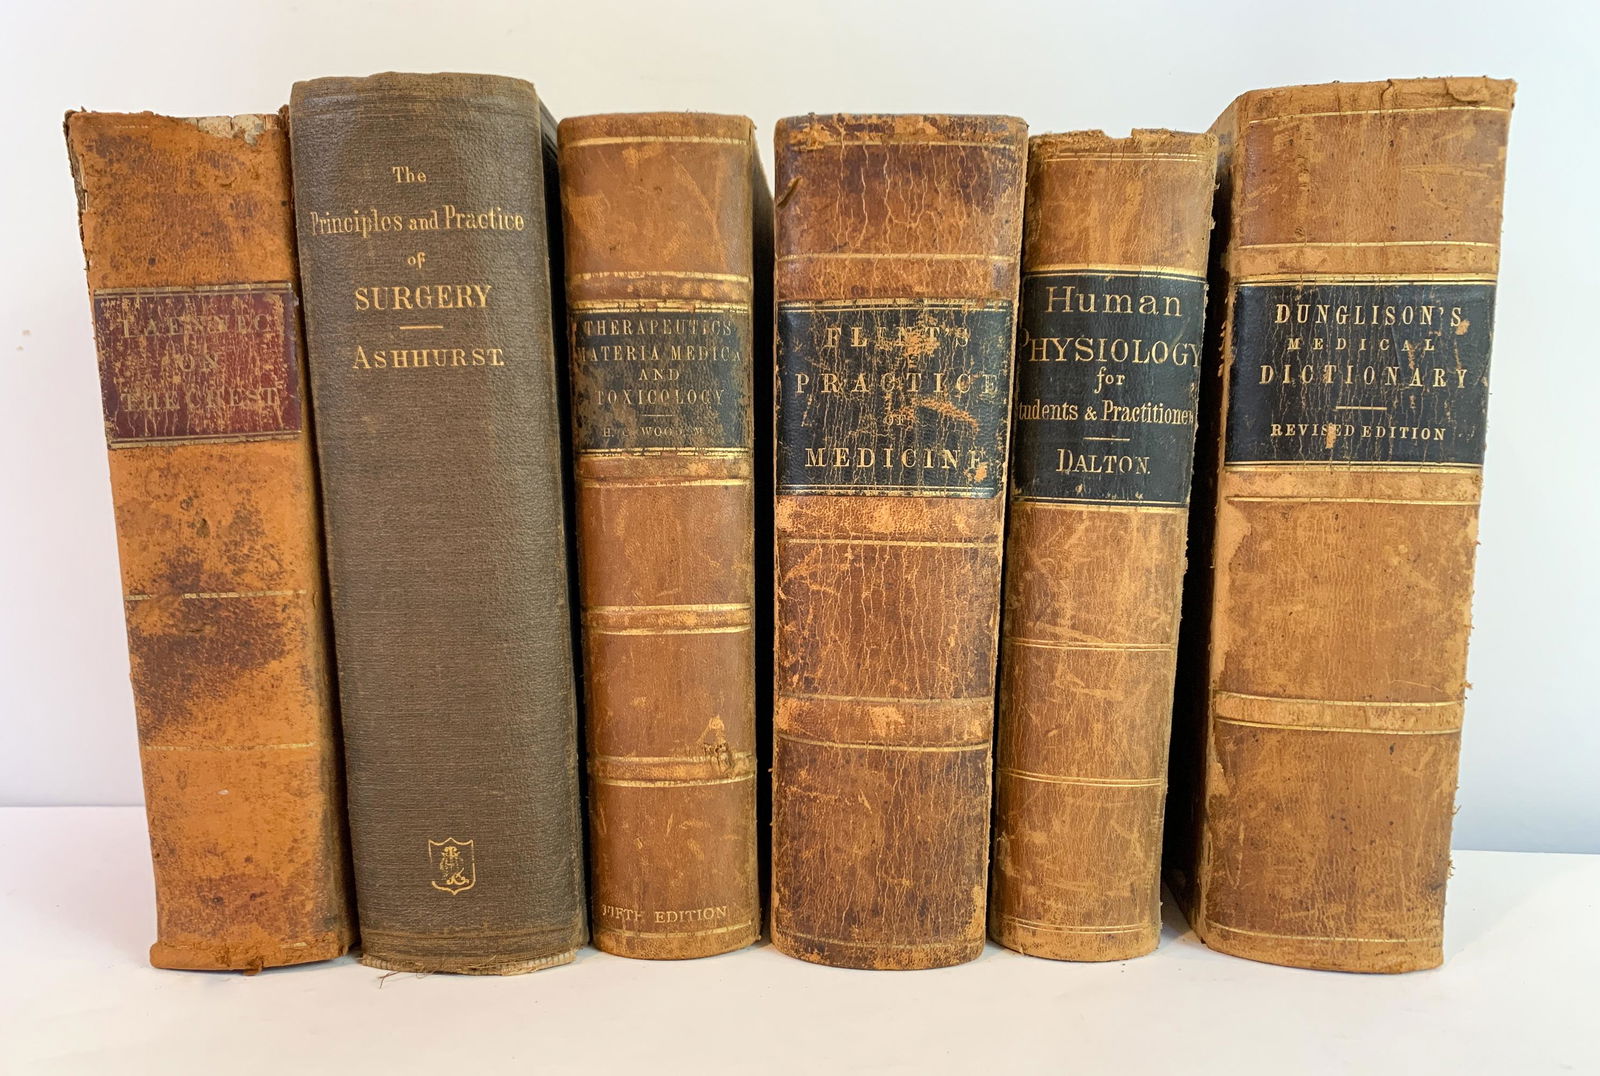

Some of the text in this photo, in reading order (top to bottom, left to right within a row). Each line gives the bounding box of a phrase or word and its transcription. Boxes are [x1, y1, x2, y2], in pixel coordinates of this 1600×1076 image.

[392, 166, 427, 183] The
[310, 204, 525, 238] Principles and Practice
[407, 252, 426, 269] of
[355, 285, 492, 311] SURGERY
[1044, 285, 1182, 317] Human
[1274, 303, 1464, 327] DUNGLISON'S
[583, 319, 733, 336] THERAPEUTICS
[671, 345, 741, 362] MEDICA
[1287, 338, 1436, 351] MEDICAL
[638, 368, 680, 381] AND
[795, 372, 999, 394] PRACTICE
[1093, 366, 1126, 394] for
[1259, 364, 1468, 389] DICTIONARY
[120, 387, 279, 412] THE CHEST
[597, 388, 725, 406] TOXICOLOGY
[1018, 399, 1079, 421] tudents
[1084, 406, 1098, 421] &
[1270, 423, 1447, 441] REVISED EDITION
[654, 905, 728, 924] EDITION
